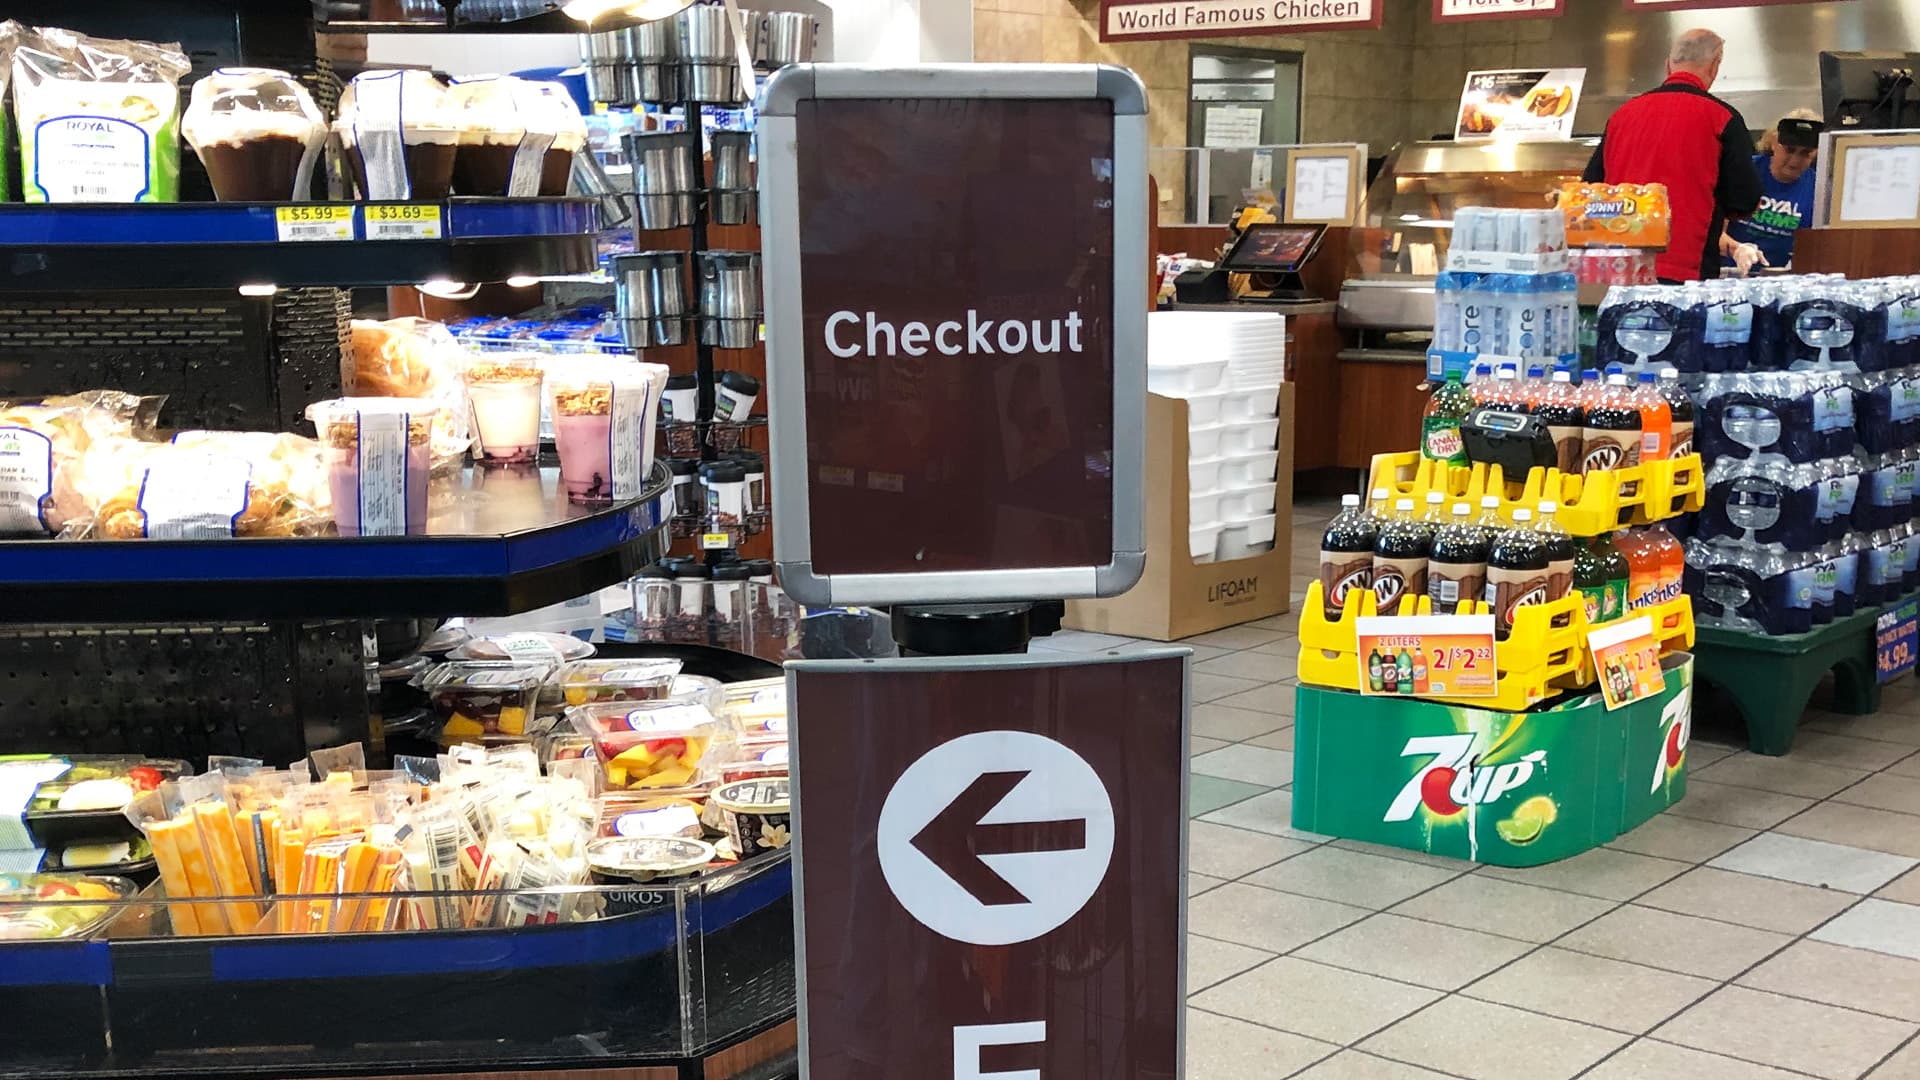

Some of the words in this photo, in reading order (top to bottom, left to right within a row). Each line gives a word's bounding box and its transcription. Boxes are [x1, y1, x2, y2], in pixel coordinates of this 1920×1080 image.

[1119, 10, 1176, 29] World
[1185, 6, 1265, 25] Famous
[1274, 1, 1359, 19] Chicken
[66, 121, 114, 133] ROYAL
[291, 207, 333, 220] $5.99
[379, 206, 421, 219] $3.69
[1758, 195, 1802, 217] OYAL
[1752, 210, 1799, 230] ARMS
[824, 308, 1083, 358] Checkout
[1207, 576, 1258, 602] LIFOAM
[1387, 637, 1421, 646] LITERS
